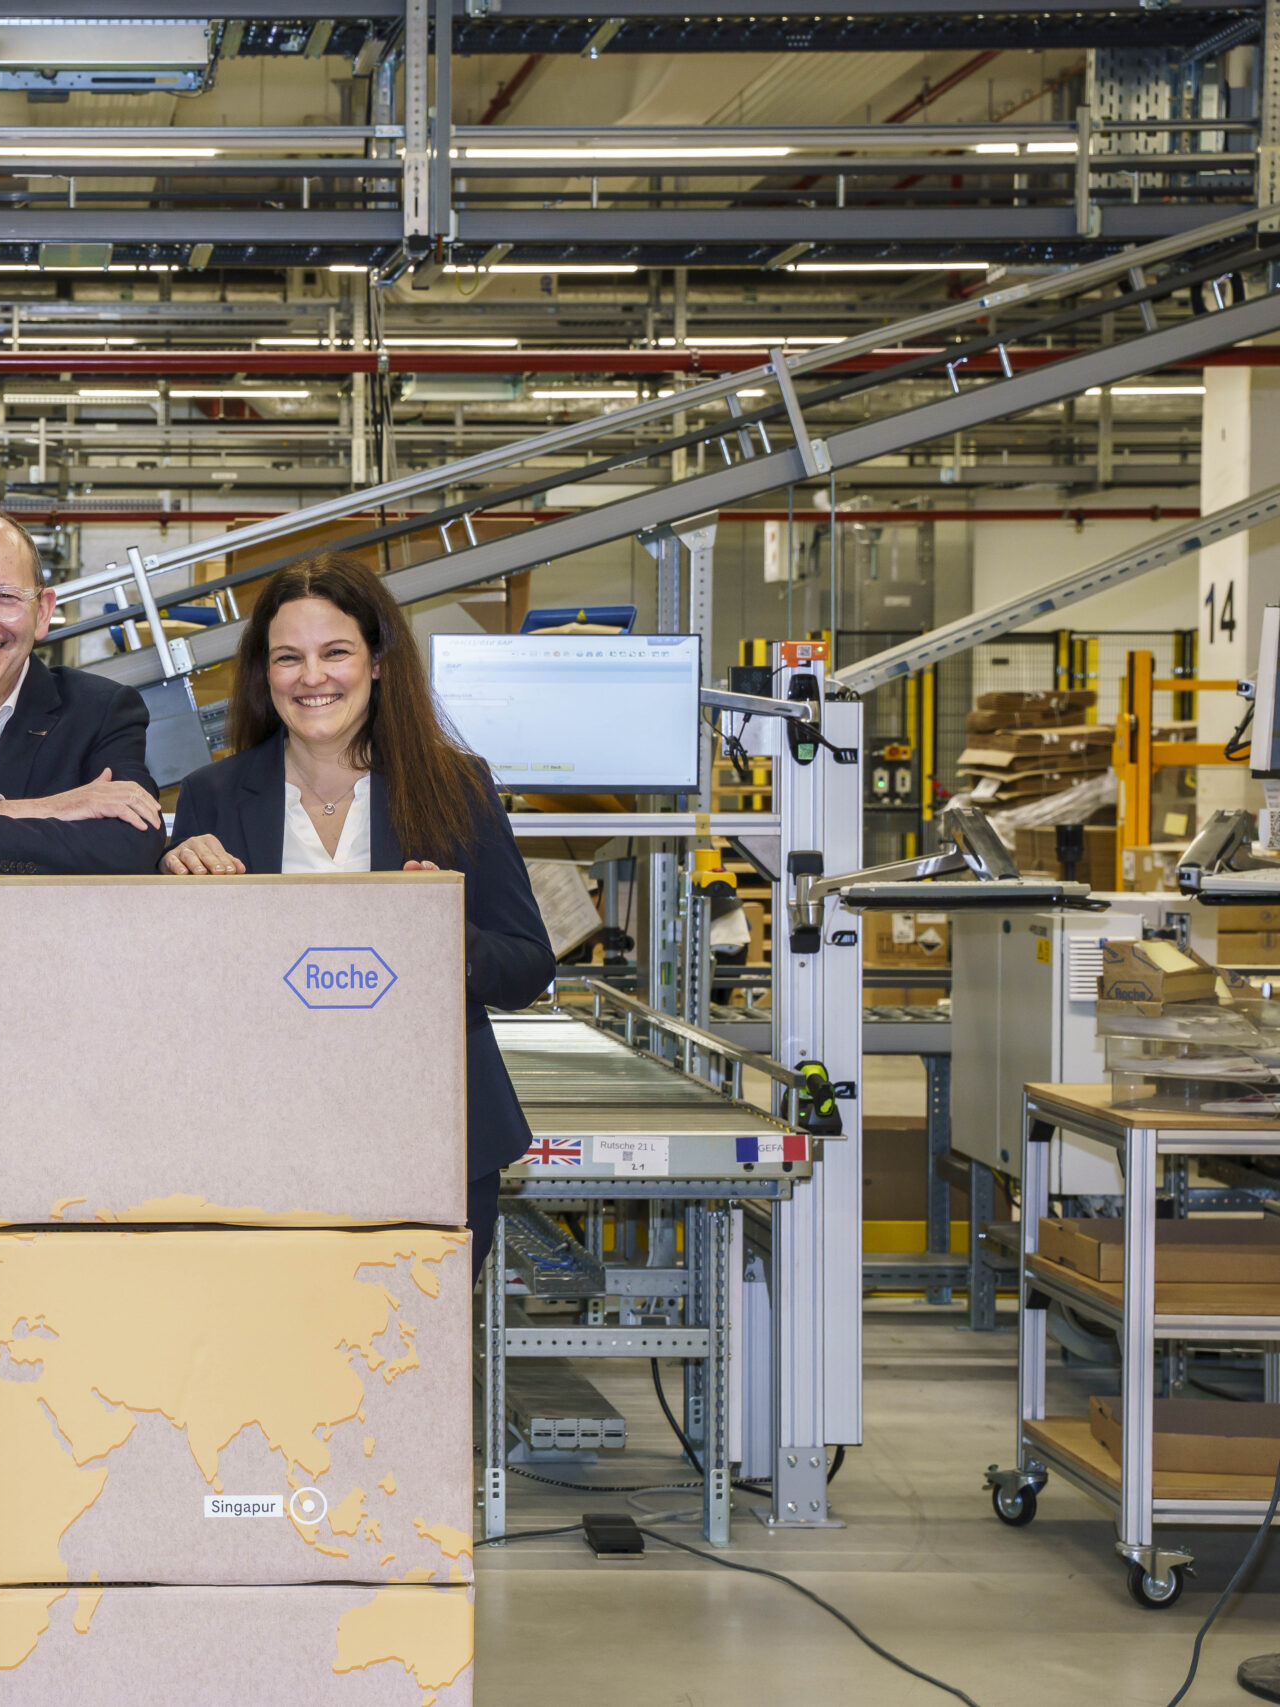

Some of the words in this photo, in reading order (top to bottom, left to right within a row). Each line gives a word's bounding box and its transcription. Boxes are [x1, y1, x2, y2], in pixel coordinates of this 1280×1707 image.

[1204, 580, 1236, 644] 14
[306, 964, 379, 989] Roche
[1115, 987, 1146, 1000] Roche
[600, 1141, 635, 1150] Rutsche
[638, 1143, 648, 1151] 21
[211, 1500, 276, 1516] Singapur
